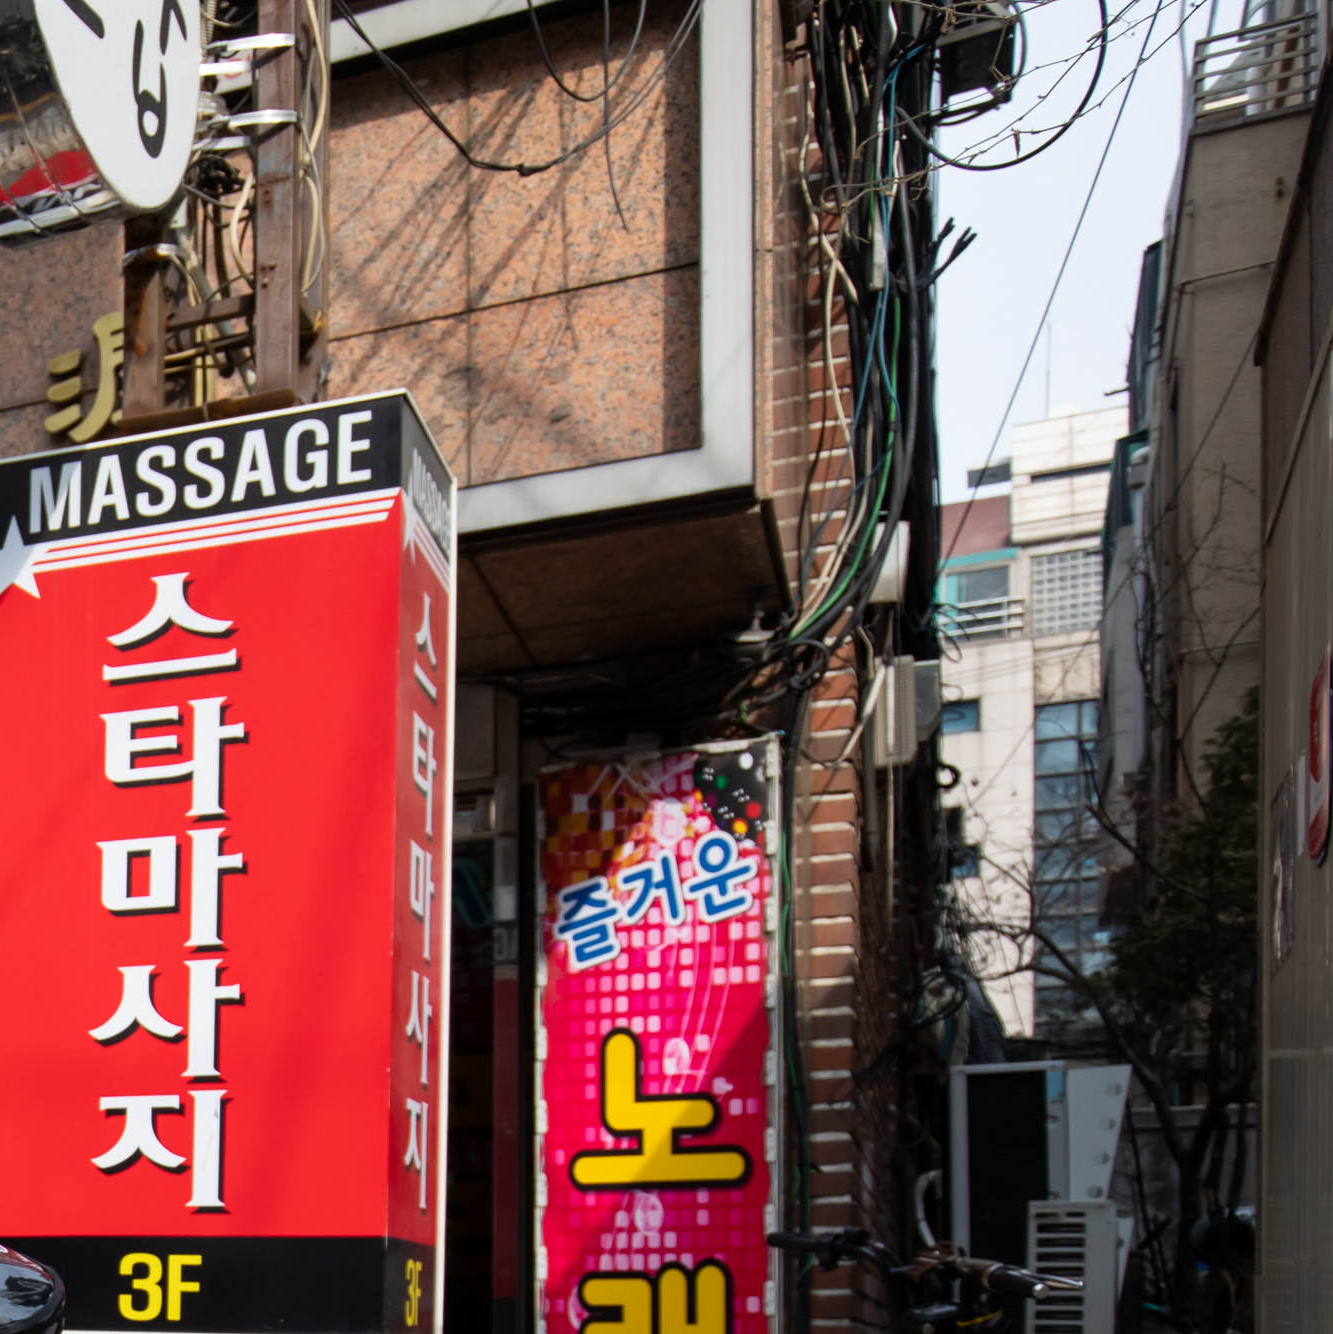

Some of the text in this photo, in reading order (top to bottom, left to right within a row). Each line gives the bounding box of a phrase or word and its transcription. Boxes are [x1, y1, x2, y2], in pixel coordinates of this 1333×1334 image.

[29, 410, 372, 534] MASSAGE
[88, 571, 247, 1210] 스타마사지
[404, 592, 439, 1212] 스타마사지
[555, 830, 756, 967] 즐거운
[118, 1253, 203, 1322] 3F
[405, 1259, 422, 1327] 3F
